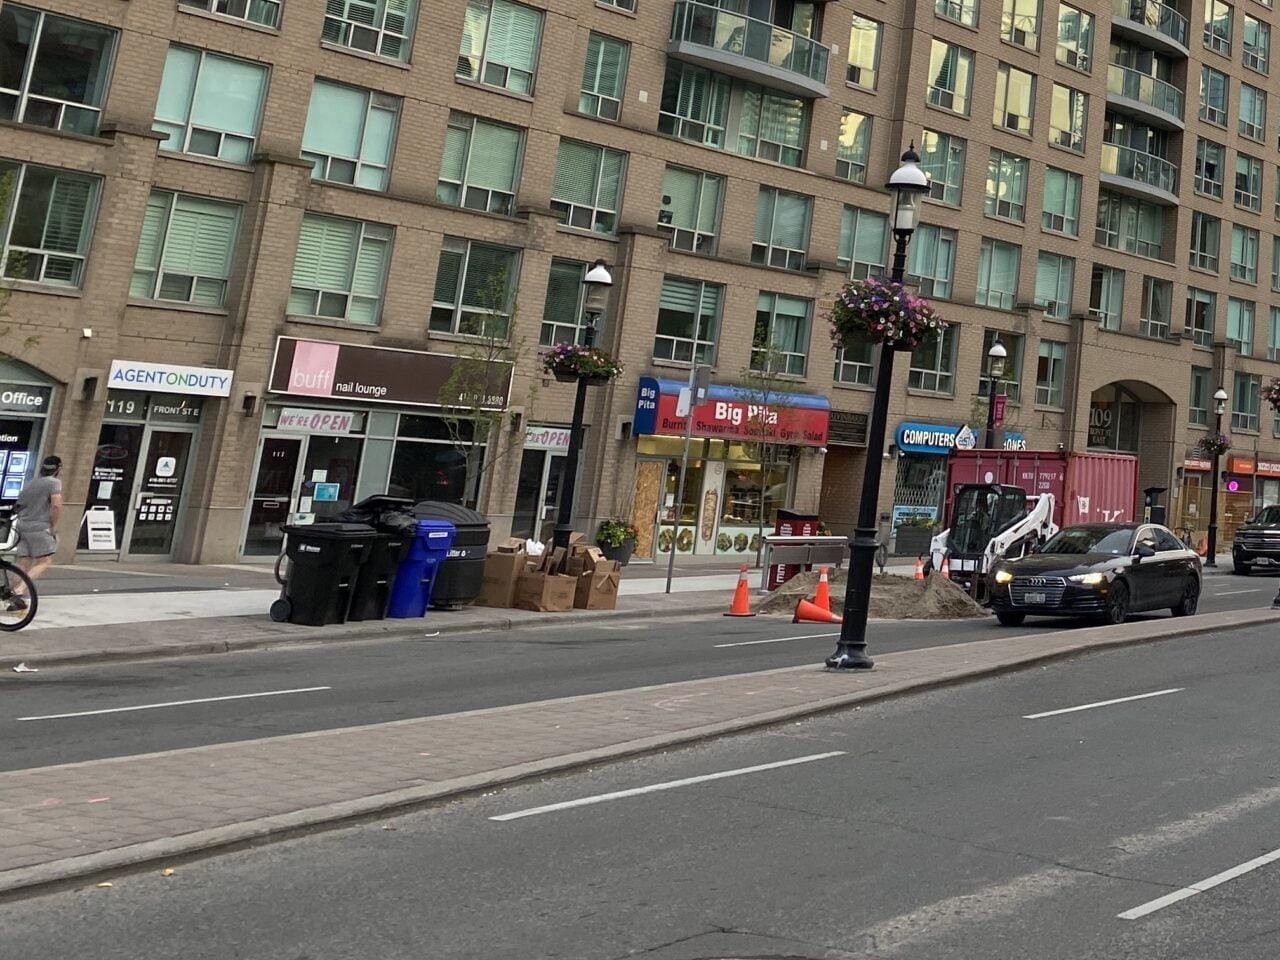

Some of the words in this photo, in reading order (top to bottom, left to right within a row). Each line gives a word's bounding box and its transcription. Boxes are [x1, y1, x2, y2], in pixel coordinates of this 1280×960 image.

[113, 368, 228, 389] AGENTONDUTY
[292, 369, 330, 390] buff
[335, 382, 354, 393] nail
[355, 382, 387, 397] lounge
[641, 387, 656, 399] Big
[1, 391, 43, 406] Office
[638, 399, 656, 409] Pita
[107, 400, 135, 414] 119
[153, 405, 181, 415] FRONT
[182, 407, 192, 416] ST
[715, 401, 743, 426] Big
[747, 404, 778, 425] Pita
[280, 413, 309, 427] WE'RE
[309, 413, 352, 431] OPEN
[1090, 408, 1112, 428] 109
[903, 429, 955, 447] COMPUTERS
